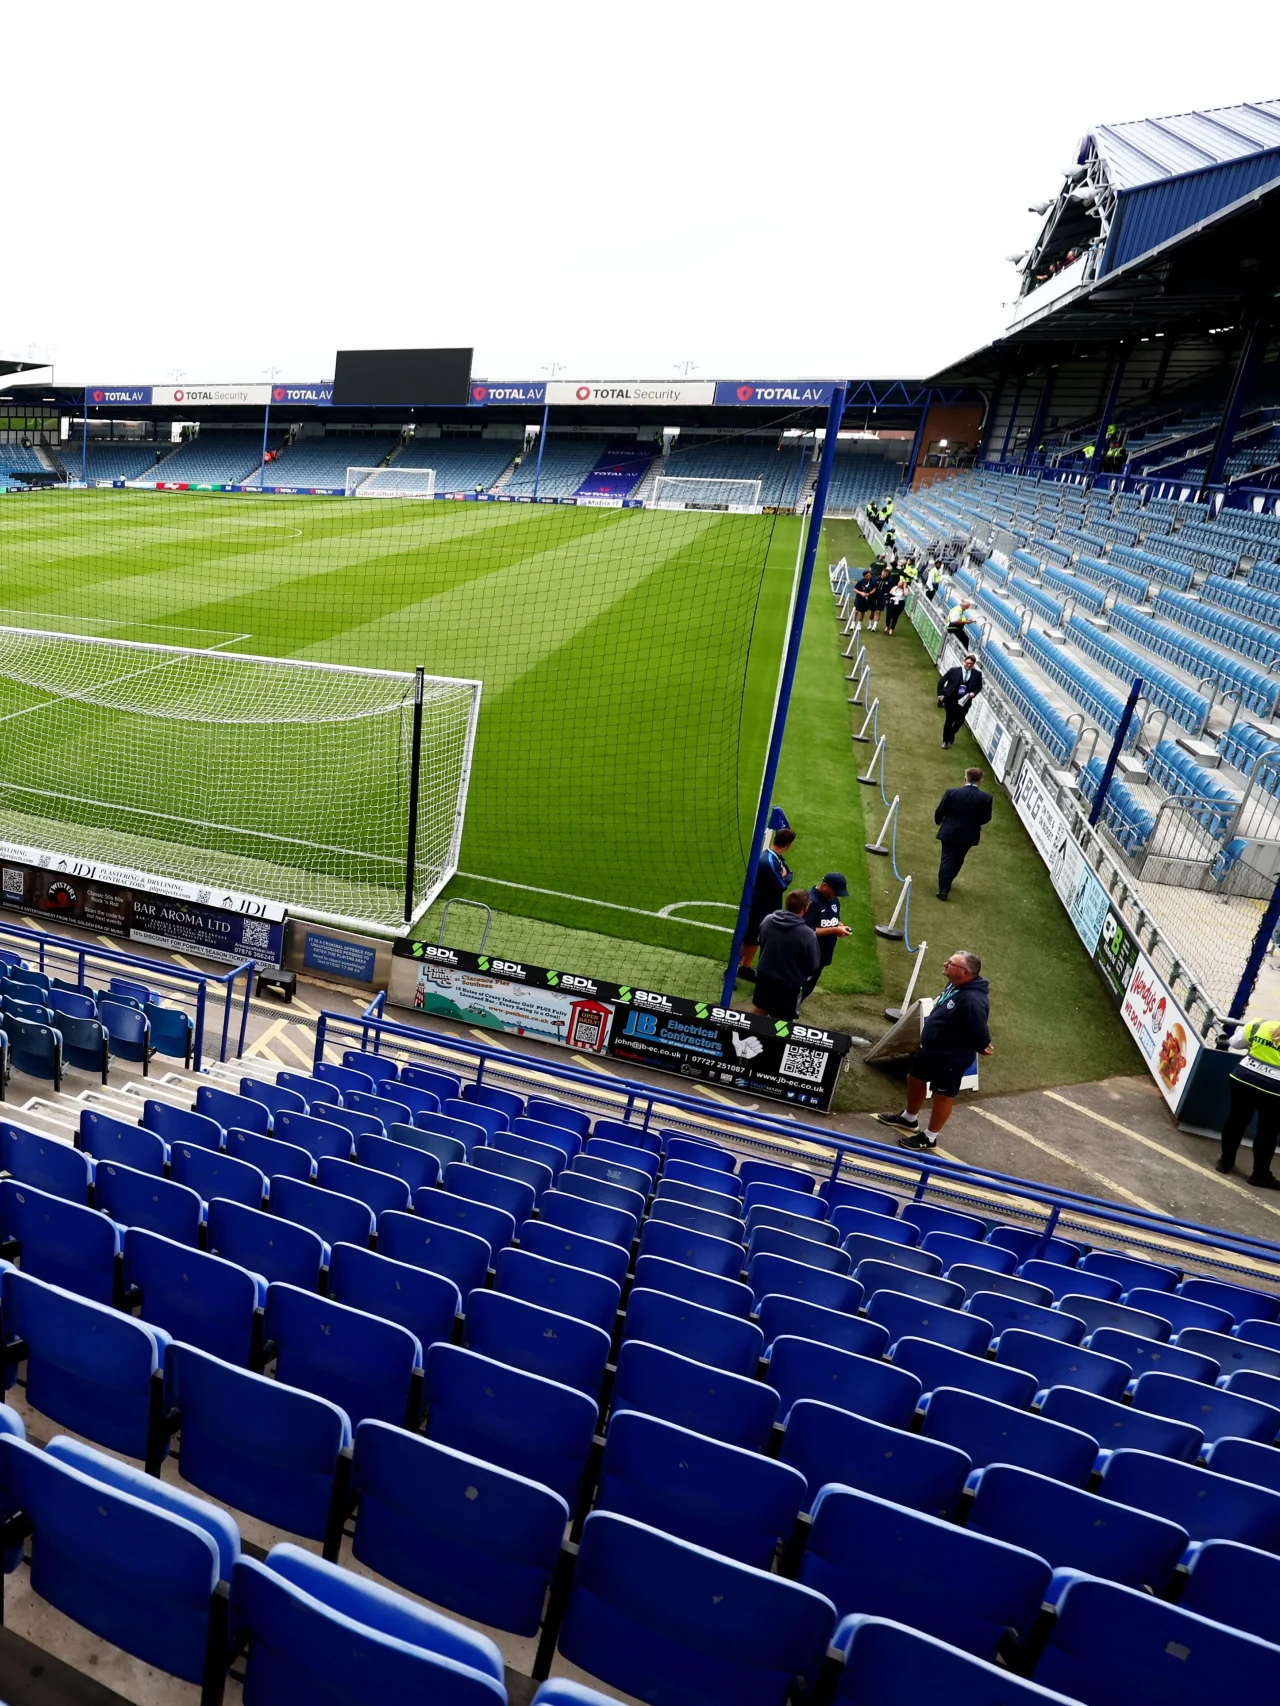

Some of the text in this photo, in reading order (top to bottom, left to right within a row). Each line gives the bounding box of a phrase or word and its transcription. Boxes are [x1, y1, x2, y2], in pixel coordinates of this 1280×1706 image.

[104, 391, 131, 400] TOTAL
[186, 390, 248, 401] TOTAL Security
[286, 389, 318, 399] TOTAL
[488, 388, 526, 399] TOTAL
[593, 388, 681, 401] TOTAL Security
[755, 388, 801, 400] TOTAL
[587, 499, 611, 507] Matrix
[1021, 778, 1044, 821] BCG
[68, 861, 97, 879] JDI
[100, 867, 140, 882] PLASTERING
[146, 877, 184, 892] DRYLINING
[86, 889, 104, 899] Classic
[98, 874, 192, 900] CONTRACTORS jdiprojects.com
[90, 896, 102, 905] Rock
[84, 906, 96, 916] Scan
[97, 908, 105, 917] the
[105, 911, 117, 919] code
[235, 899, 268, 918] JDI
[25, 906, 56, 919] ENTERTAINMENT
[56, 913, 68, 922] FROM
[77, 919, 94, 929] GOLDEN
[106, 916, 122, 926] events
[133, 901, 156, 916] BAR
[159, 907, 204, 927] AROMA
[207, 918, 231, 933] LTD
[132, 929, 144, 938] 10%
[143, 932, 171, 945] DISCOUNT
[170, 939, 182, 948] FOR
[182, 942, 206, 954] POMPEY
[205, 947, 228, 960] SEASON
[323, 941, 344, 950] CRIMINAL
[344, 945, 364, 955] OFFENCE
[313, 948, 328, 956] ENTER
[336, 953, 355, 963] PLAYING
[343, 950, 363, 960] PERSONS
[425, 945, 459, 961] SDL
[491, 960, 527, 975] SDL
[461, 974, 510, 986] Clarence Pier
[461, 980, 494, 989] Southsea
[561, 974, 598, 990] SDL
[1130, 965, 1157, 1015] Wendy's
[459, 991, 484, 1003] Licensed
[484, 997, 495, 1005] Bar
[498, 1001, 515, 1011] Every
[515, 1004, 533, 1014] Swing
[544, 1011, 561, 1020] Goal!
[463, 987, 478, 996] Holes
[484, 992, 501, 1002] Crazy
[501, 996, 521, 1006] Indoor
[521, 1000, 535, 1009] Golf
[536, 1005, 551, 1014] PLUS
[551, 1008, 568, 1018] Fully
[634, 990, 673, 1007] SDL
[578, 1017, 600, 1026] DAILY!
[580, 1012, 600, 1020] OPEN
[622, 1009, 658, 1036] JB
[711, 1006, 752, 1025] SDL
[1124, 998, 1143, 1033] WE DO IT
[667, 1019, 719, 1040] Electrical
[792, 1025, 835, 1044] SDL
[659, 1028, 723, 1050] Contractors
[683, 1043, 703, 1052] electrical
[614, 1037, 824, 1094] john@jb-ec.co.uk 07727 251087 www.jb-ec.co.uk
[749, 1081, 783, 1094] TRUSTMARK
